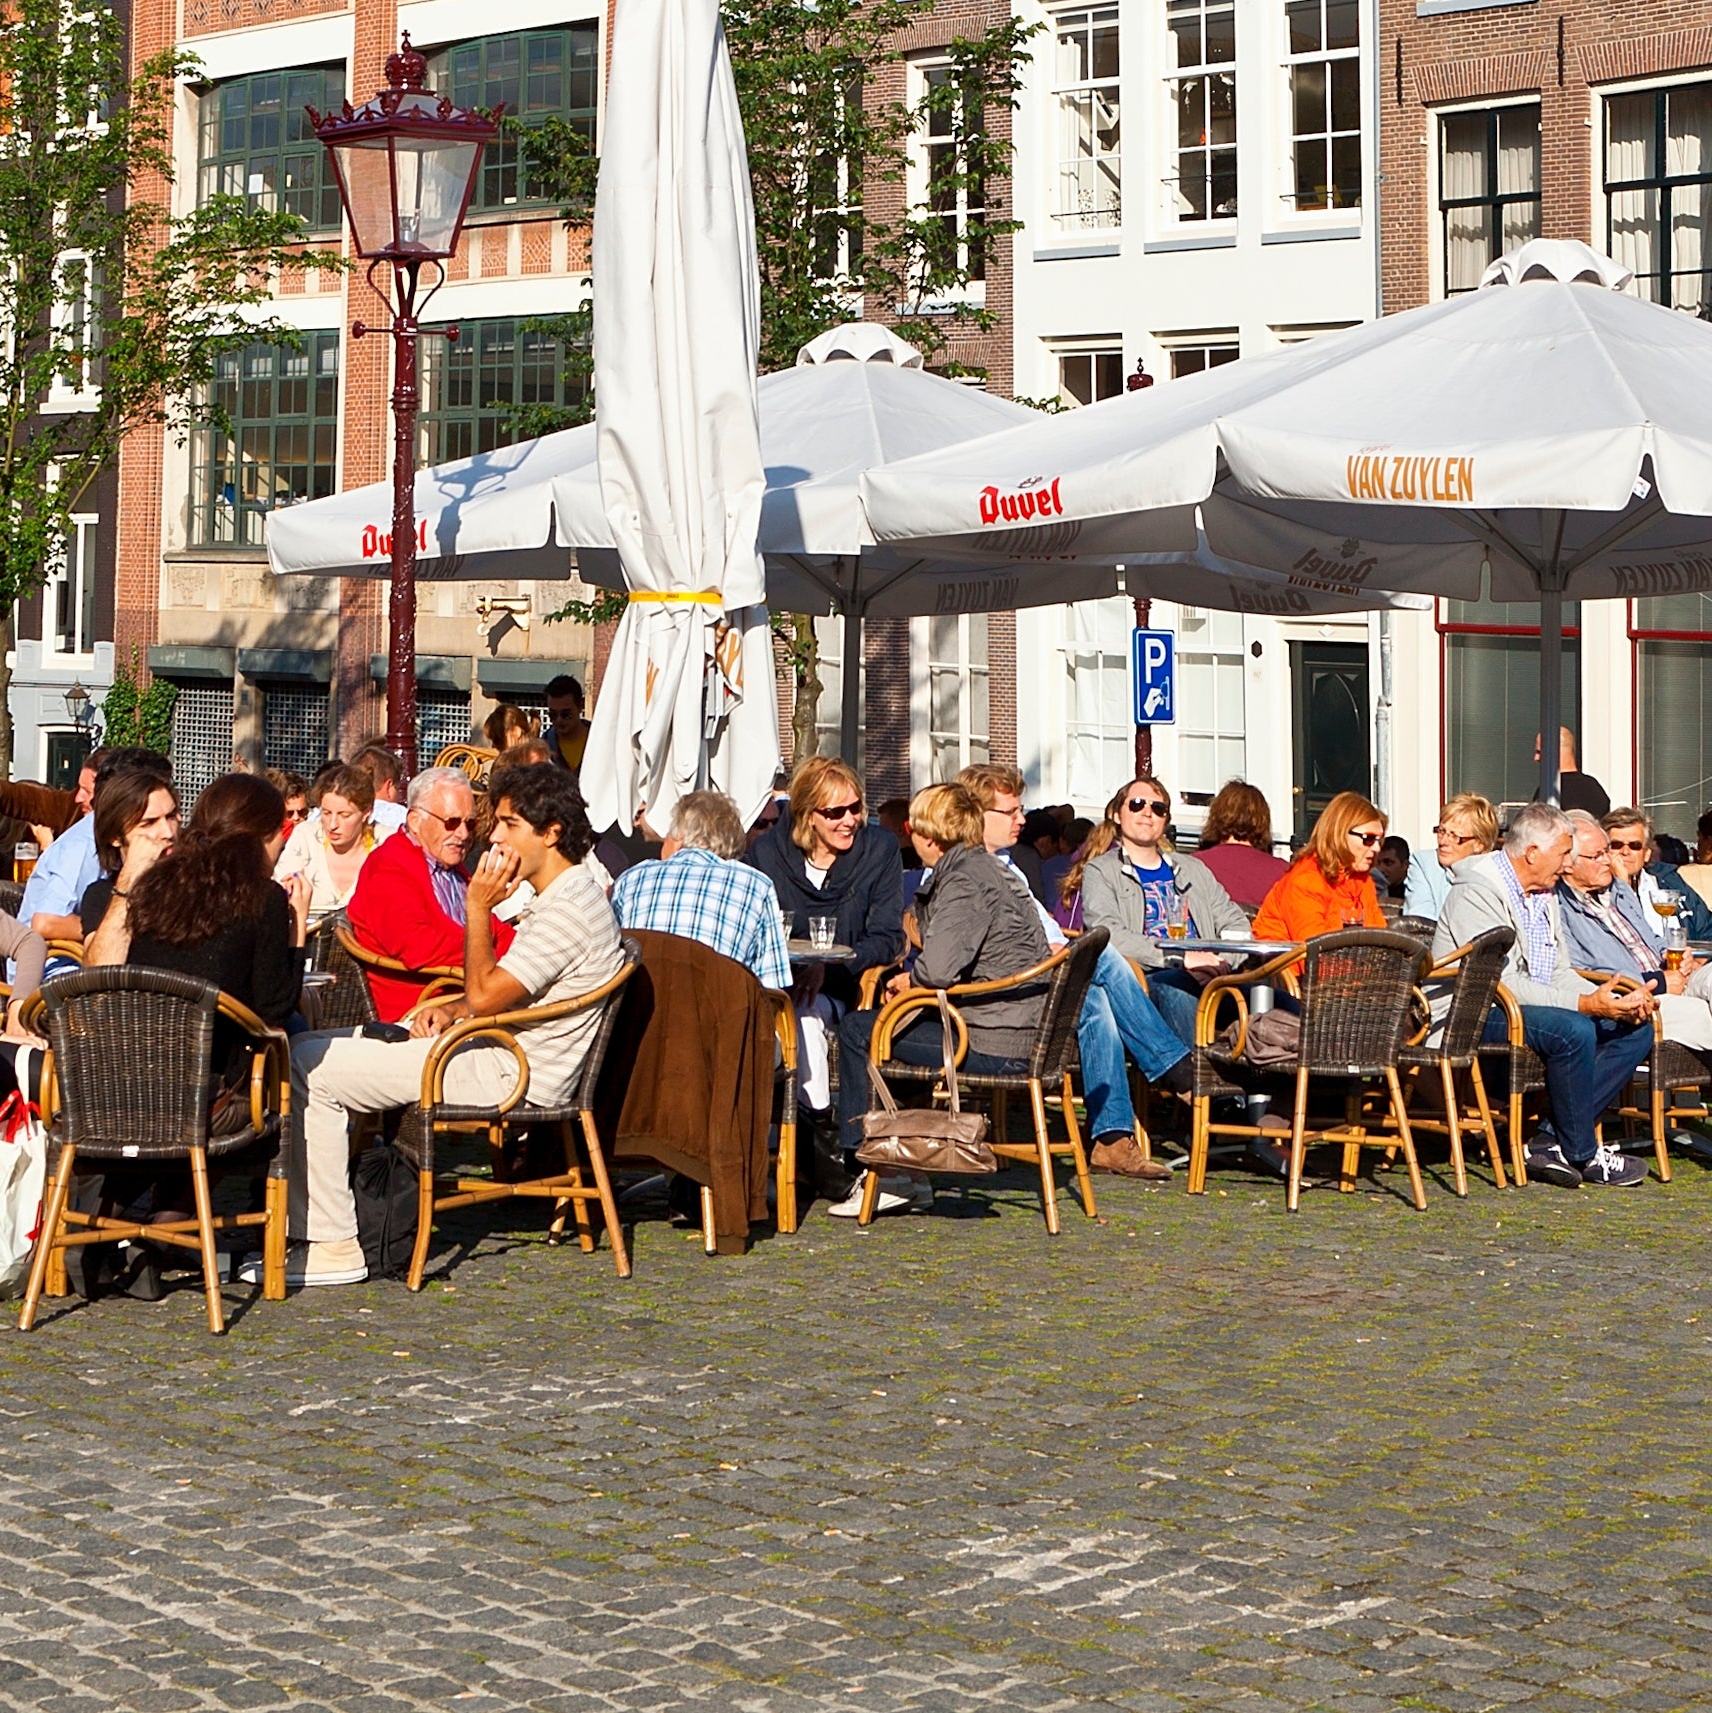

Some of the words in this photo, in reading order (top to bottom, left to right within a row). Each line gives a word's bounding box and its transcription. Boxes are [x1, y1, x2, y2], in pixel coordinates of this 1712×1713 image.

[980, 476, 1063, 525] Duvel
[1347, 455, 1388, 499] VAN
[1391, 456, 1474, 501] ZUYLEN
[1145, 638, 1166, 684] P
